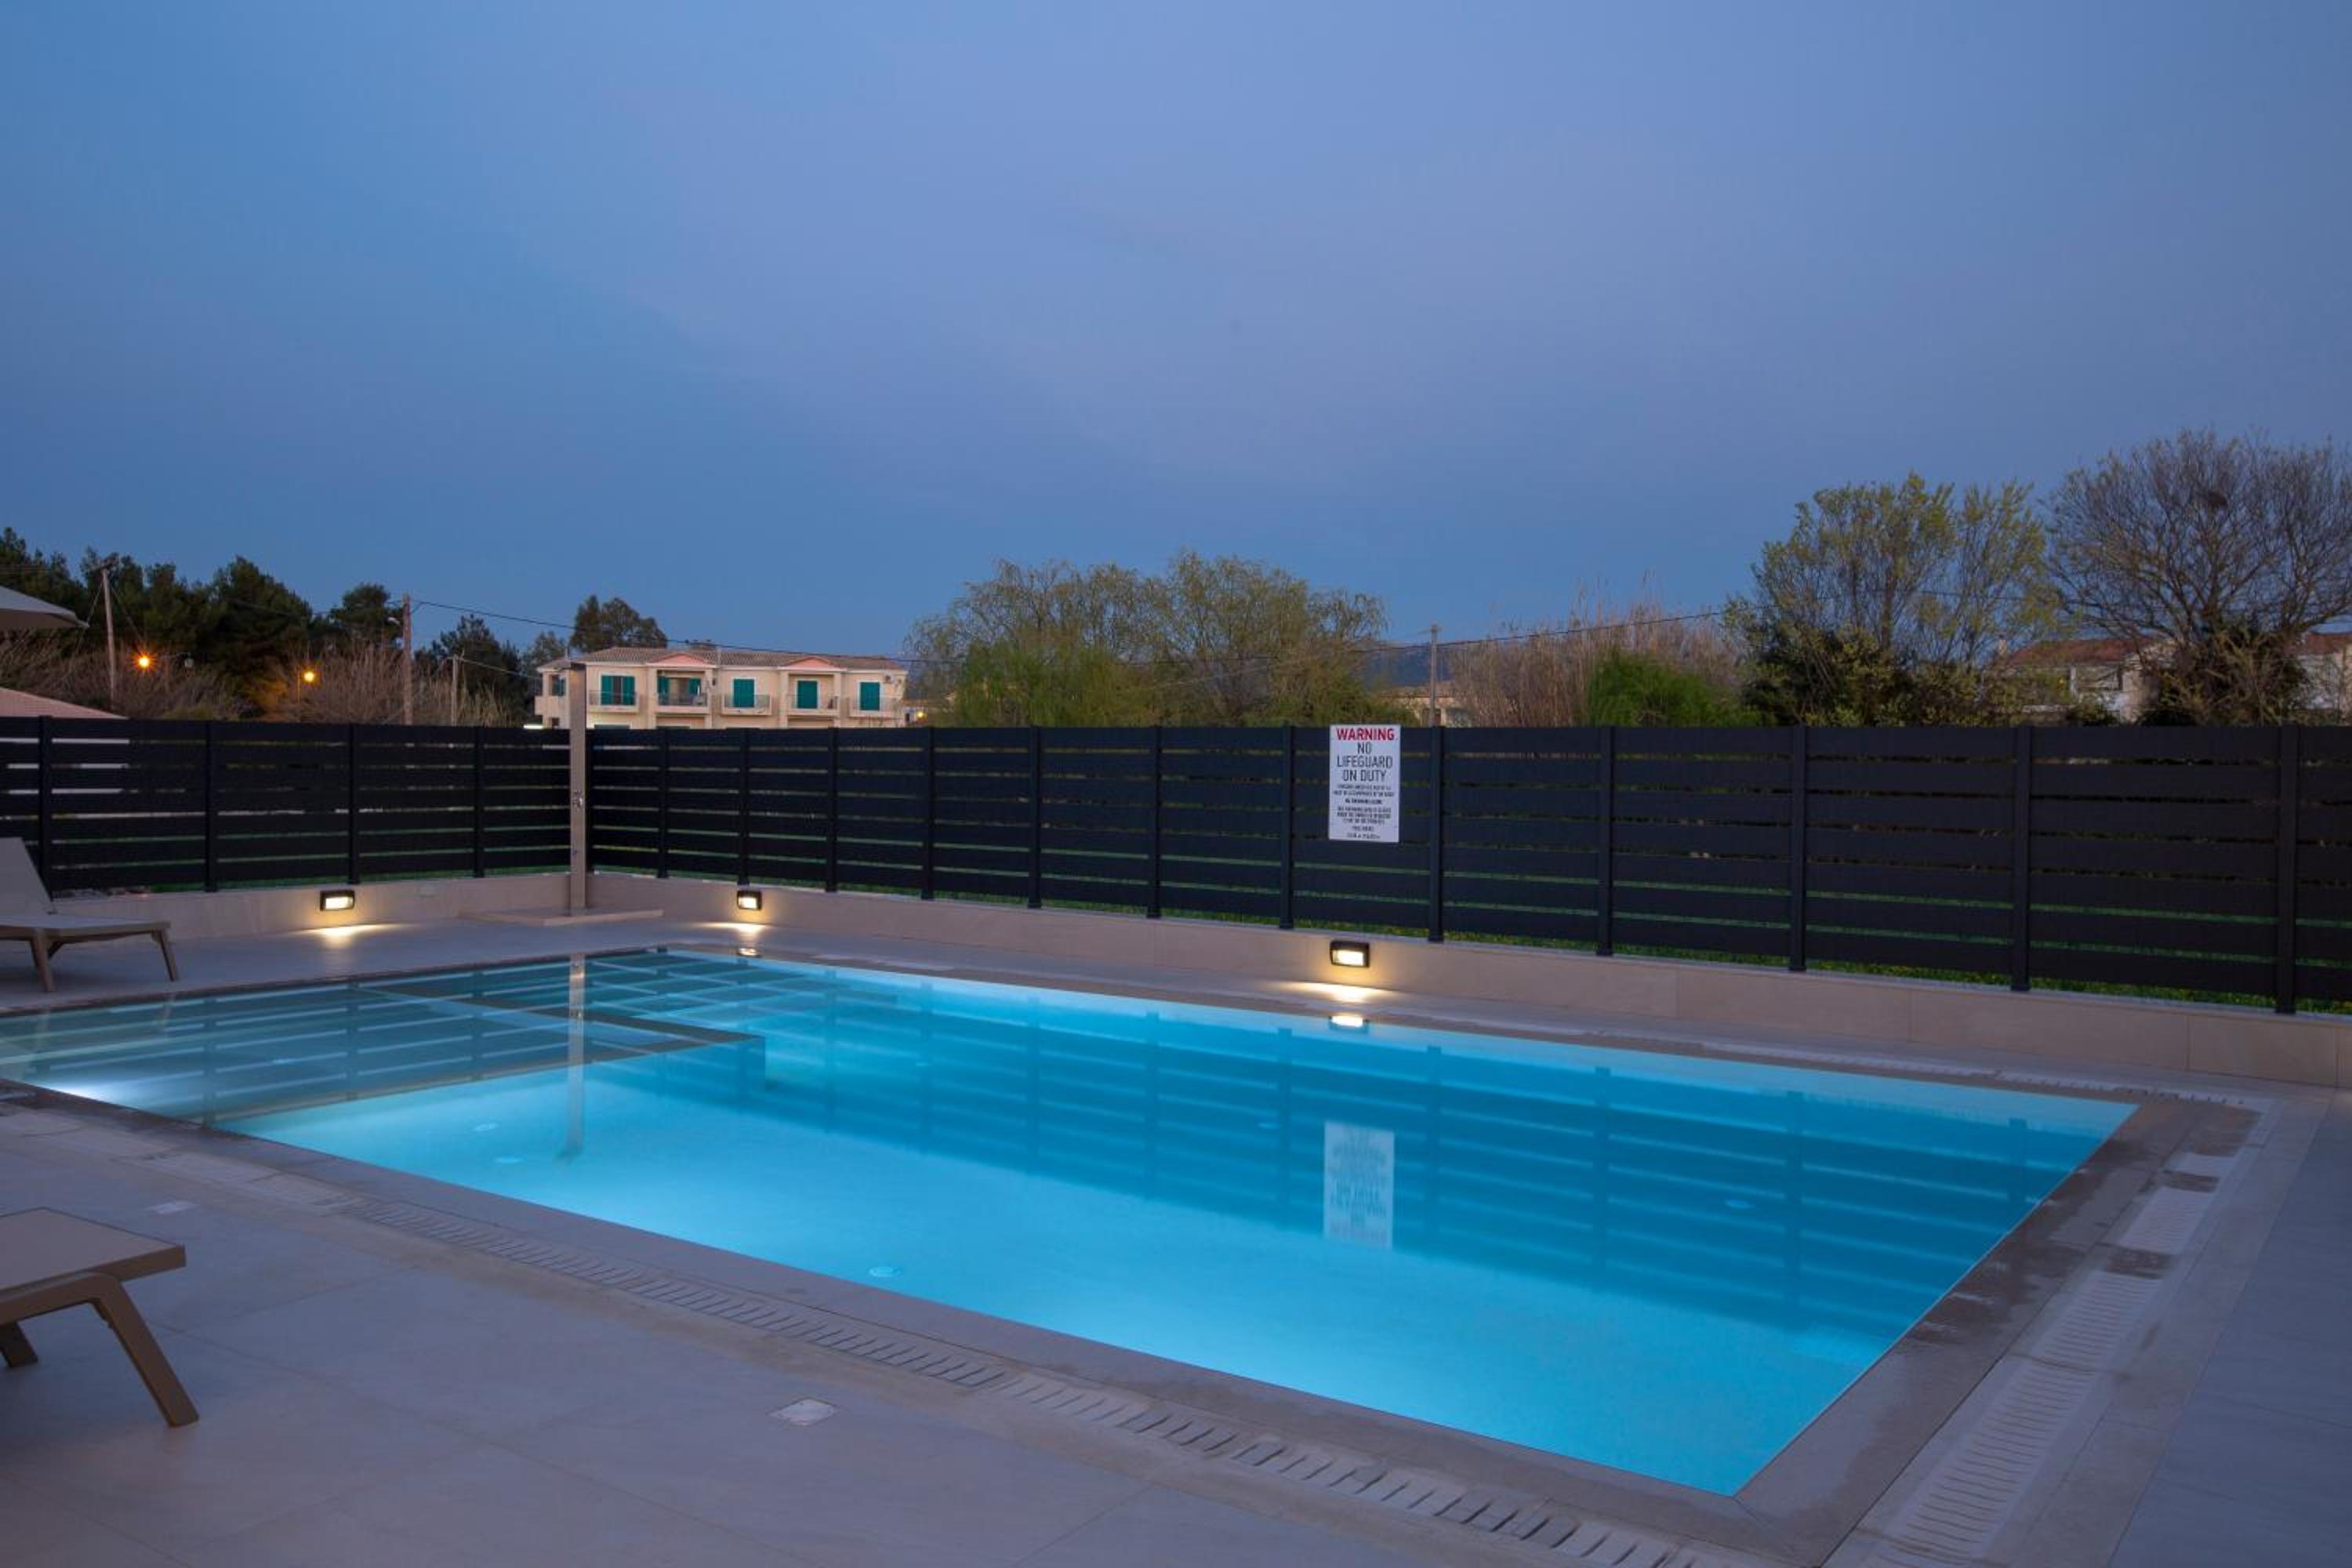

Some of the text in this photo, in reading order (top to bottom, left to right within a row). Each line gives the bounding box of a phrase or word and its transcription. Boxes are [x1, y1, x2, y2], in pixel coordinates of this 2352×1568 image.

[1336, 727, 1395, 741] WARNING
[1357, 742, 1371, 754] NO
[1337, 755, 1393, 768] LIFEGUARD
[1343, 769, 1386, 782] ON DUTY
